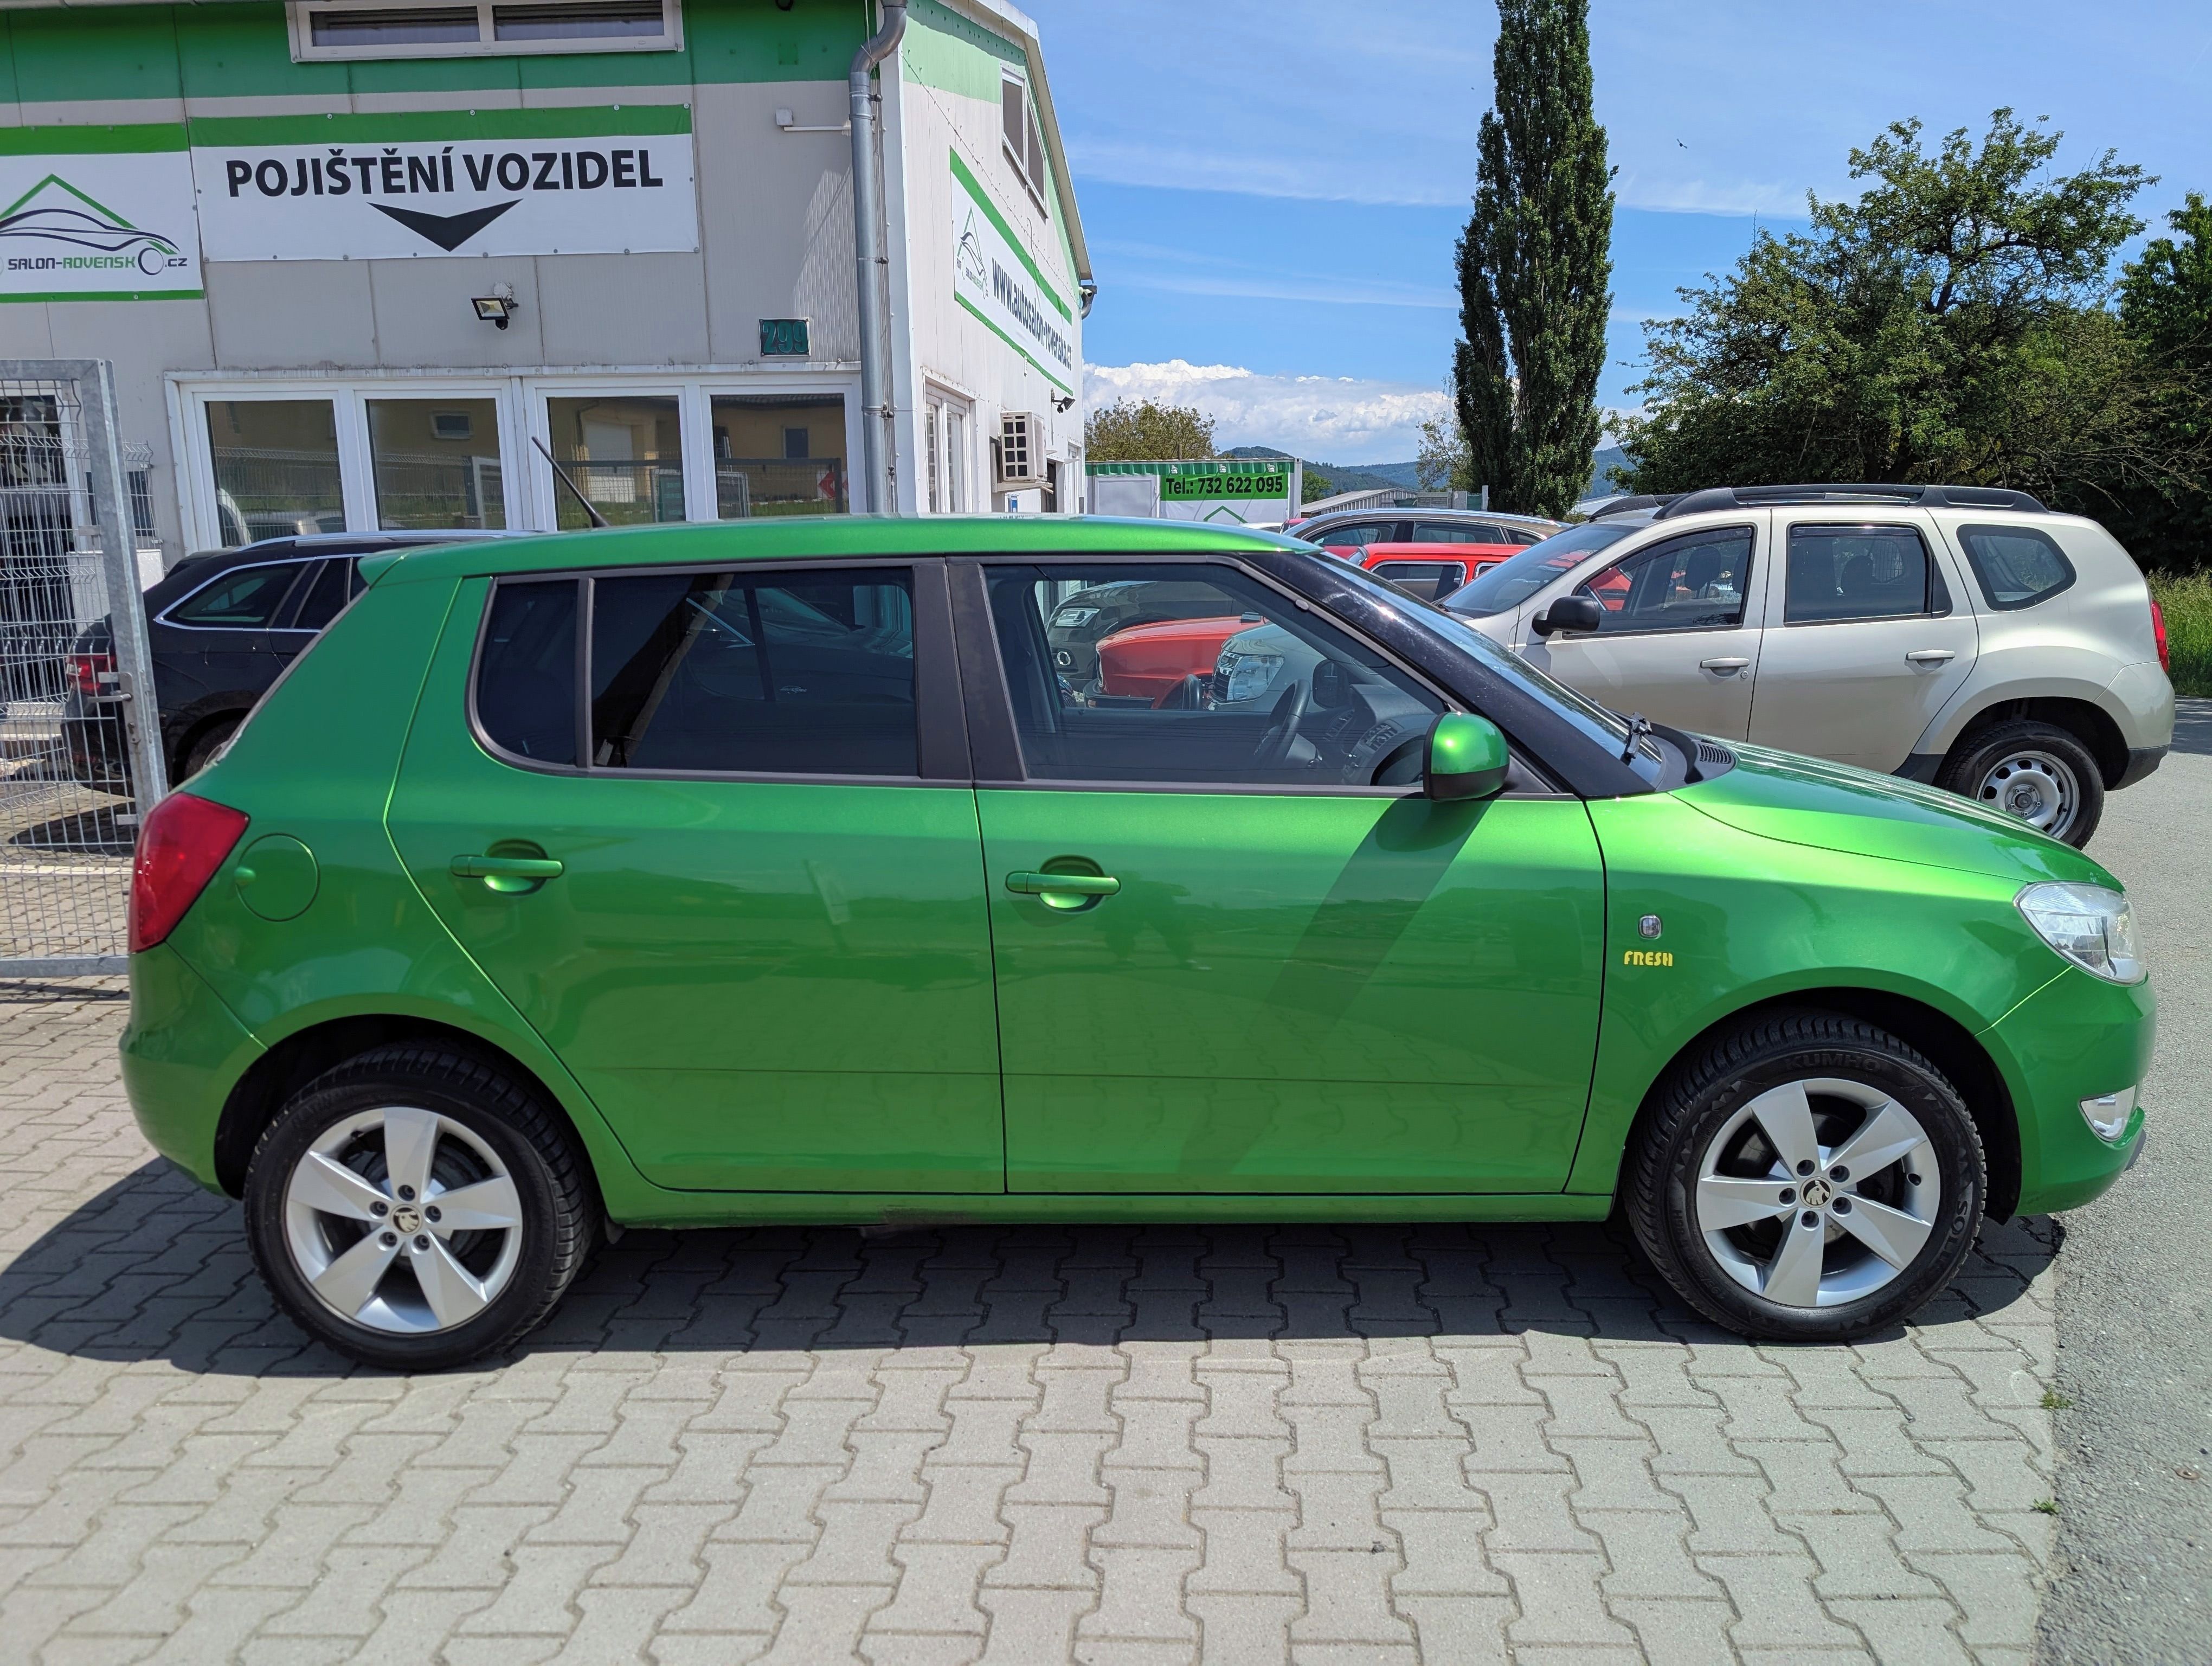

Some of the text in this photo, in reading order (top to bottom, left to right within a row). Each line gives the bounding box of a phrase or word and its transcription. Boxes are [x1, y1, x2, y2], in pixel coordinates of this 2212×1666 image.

[226, 146, 664, 197] POJIŠTĚNÍ VOZIDEL
[992, 257, 1072, 371] www.autosalon-rovensko.cz
[762, 321, 808, 353] 299
[1166, 476, 1283, 495] Tel.: 732 622 095
[1624, 951, 1674, 967] FRESH
